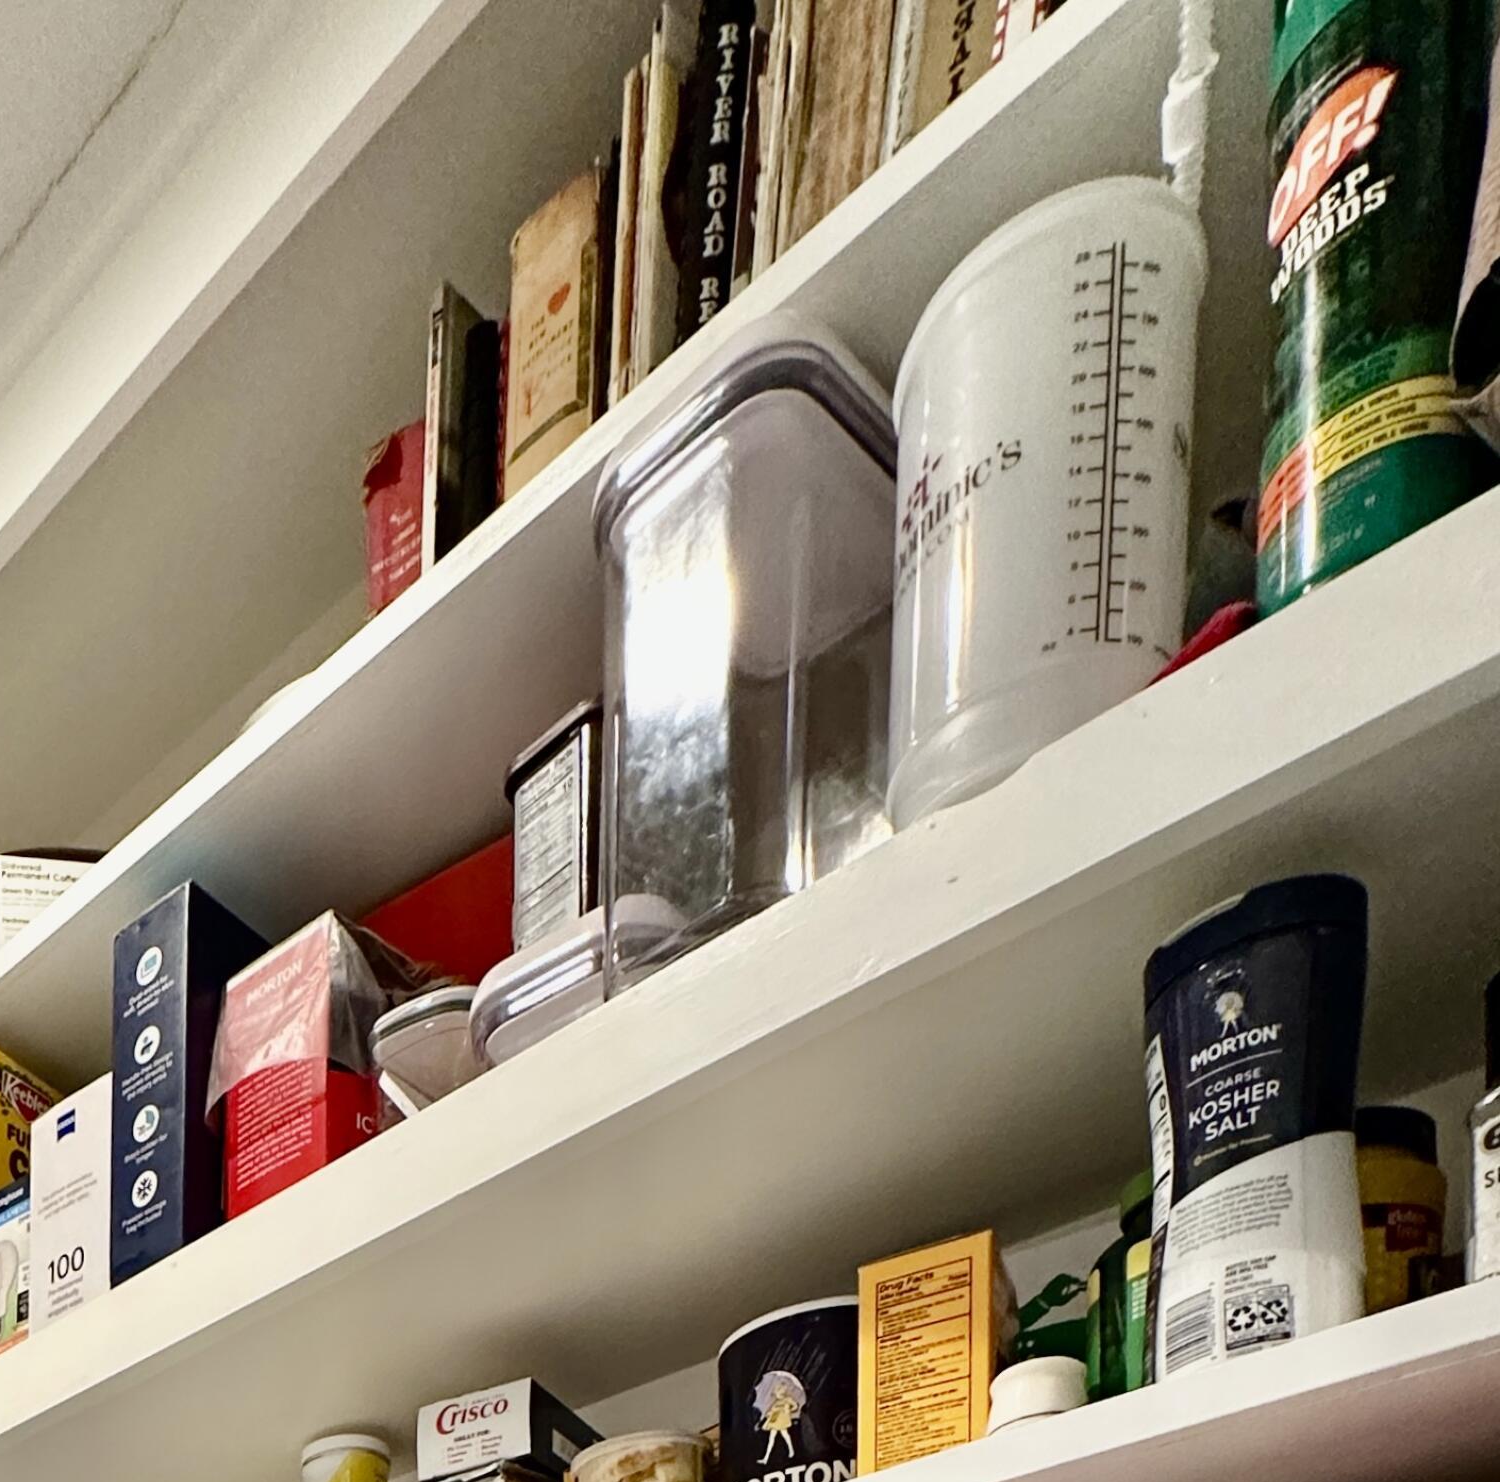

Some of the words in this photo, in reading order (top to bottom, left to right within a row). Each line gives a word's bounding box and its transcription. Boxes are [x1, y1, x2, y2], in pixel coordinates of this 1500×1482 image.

[710, 22, 739, 146] RIVER
[1267, 70, 1397, 247] OFF!
[702, 163, 727, 259] ROAD
[1281, 162, 1370, 265] DEEP
[1270, 178, 1388, 304] WOODS
[245, 959, 304, 1008] MORTON
[1189, 1024, 1280, 1073] MORTON
[1188, 1080, 1281, 1130] KOSHER
[1204, 1066, 1262, 1098] COARSE
[1204, 1106, 1261, 1142] SALT
[47, 1246, 85, 1284] 100
[879, 1277, 905, 1295] Drug
[906, 1271, 934, 1288] Facts
